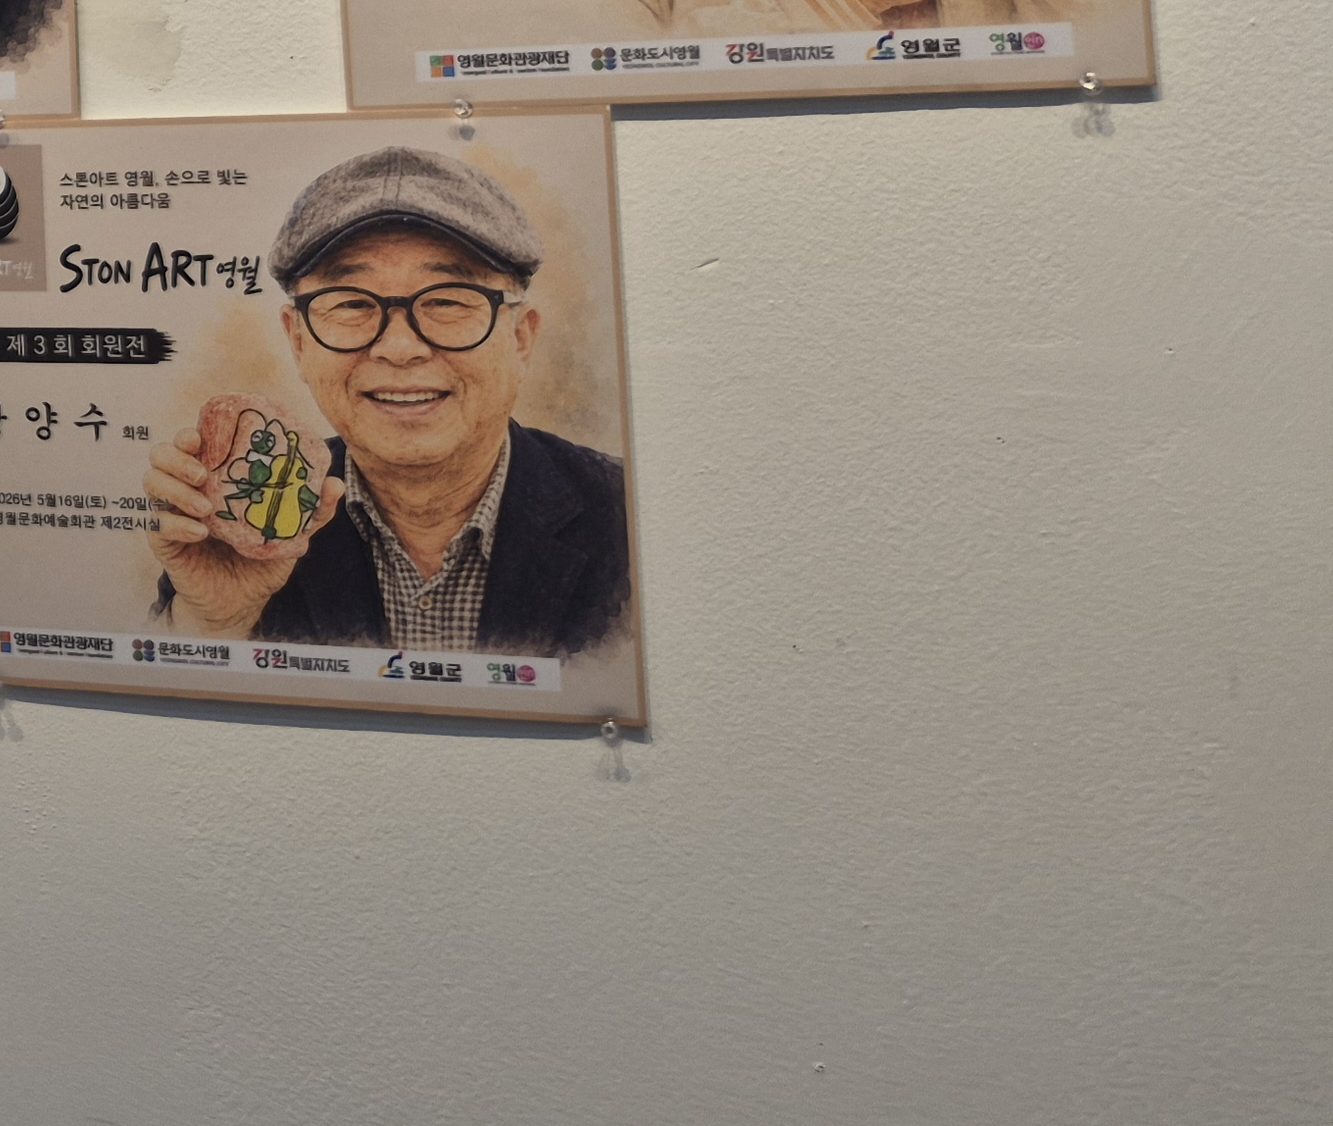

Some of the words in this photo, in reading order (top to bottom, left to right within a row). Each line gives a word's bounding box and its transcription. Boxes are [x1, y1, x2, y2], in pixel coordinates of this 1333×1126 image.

[621, 45, 700, 61] 문화도시영월
[901, 38, 960, 55] 영월군
[457, 51, 569, 68] 영월문화관광재단
[60, 172, 119, 188] 스톤아트
[125, 170, 159, 188] 영월,
[165, 169, 211, 185] 손으로
[60, 194, 104, 209] 자연의
[111, 192, 171, 209] 아름다움
[60, 244, 131, 292] STON
[81, 334, 146, 357] 회원전
[122, 426, 149, 440] 회원
[37, 494, 106, 509] 5월16일(토)
[101, 516, 160, 532] 제2전시실
[14, 632, 113, 651] 영월문화관광재단
[158, 642, 230, 659] 문화도시영월
[409, 661, 462, 676] 영월군
